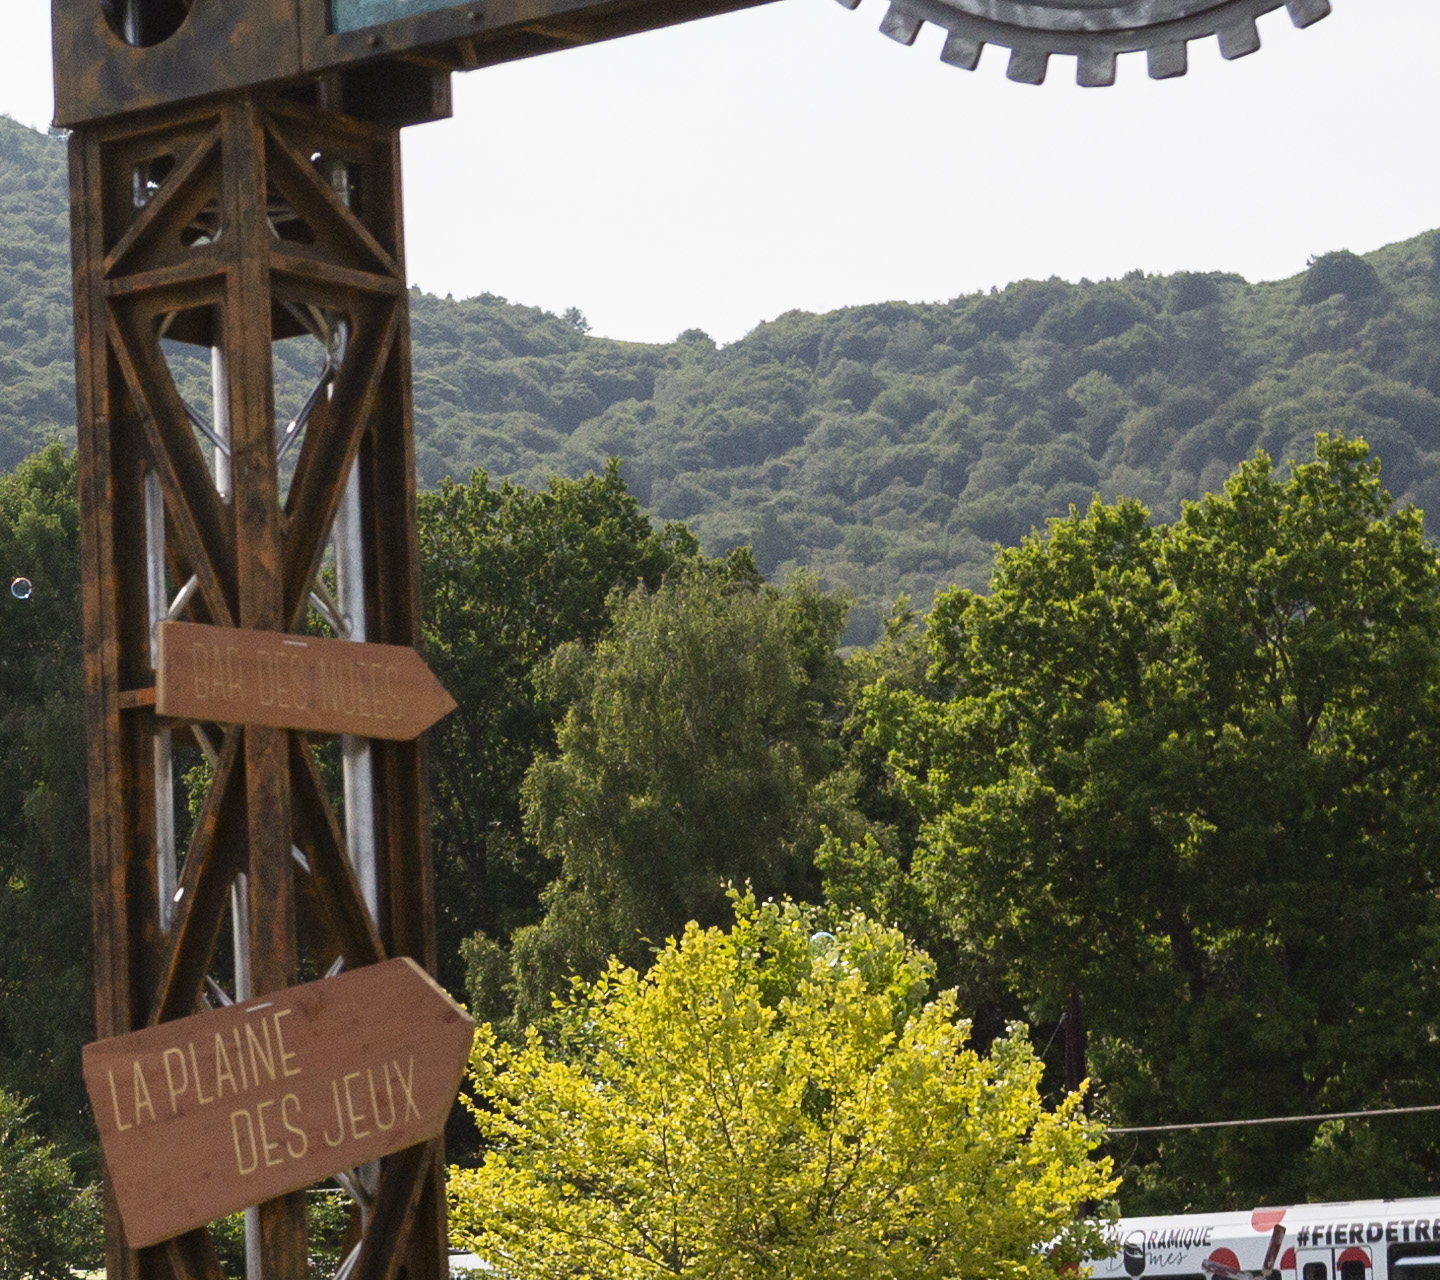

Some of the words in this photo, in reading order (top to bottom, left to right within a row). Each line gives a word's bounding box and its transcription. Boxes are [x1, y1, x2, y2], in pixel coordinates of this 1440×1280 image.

[256, 649, 308, 711] DES
[108, 1060, 157, 1132] LA
[163, 1008, 303, 1114] PLAINE
[230, 1093, 308, 1176] DES
[323, 1056, 421, 1148] JEUX
